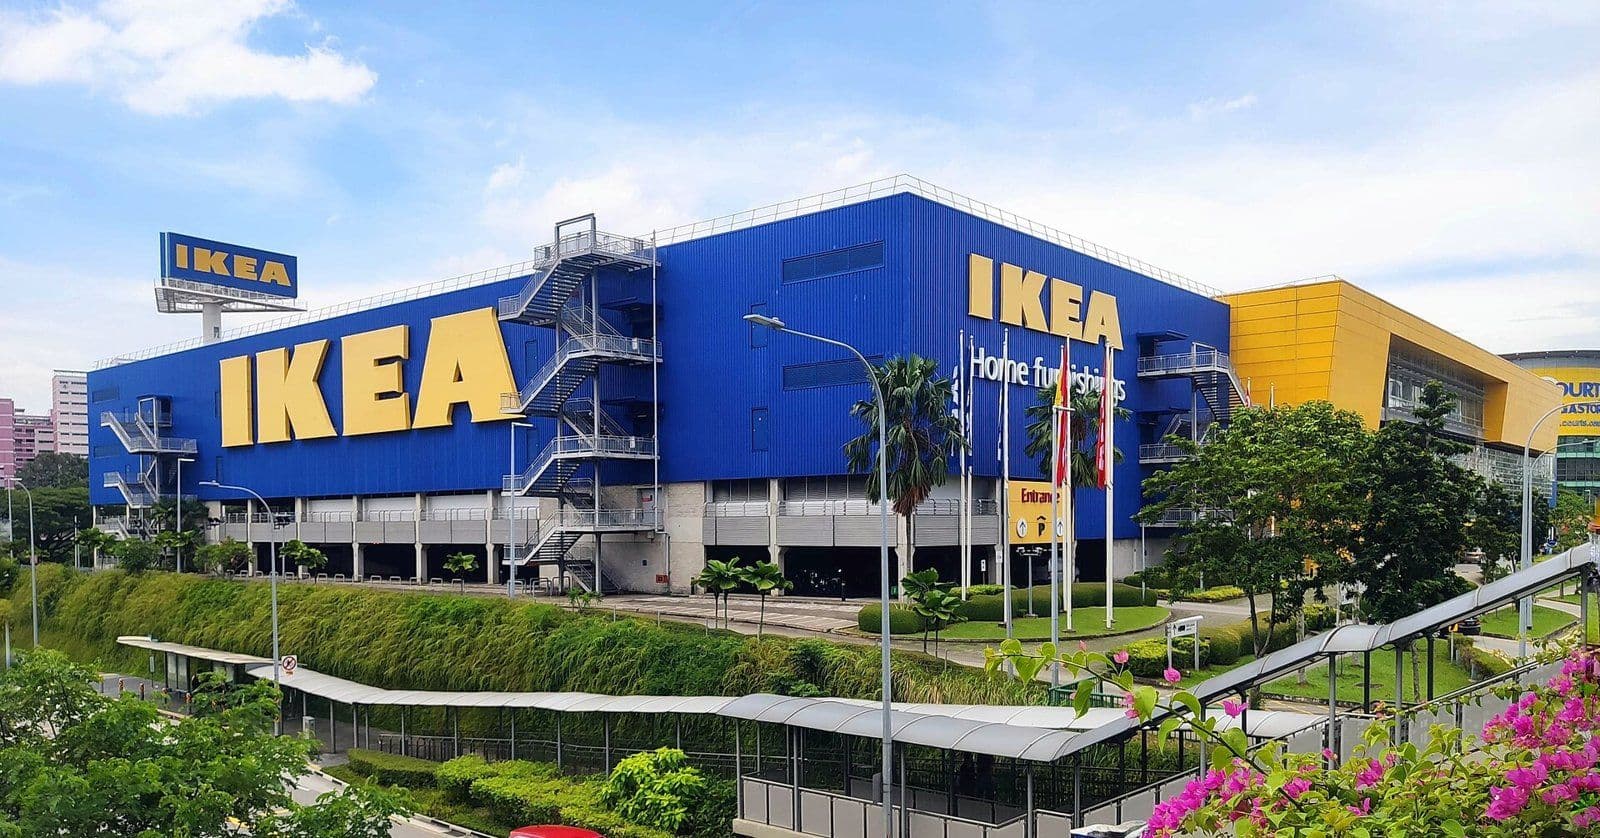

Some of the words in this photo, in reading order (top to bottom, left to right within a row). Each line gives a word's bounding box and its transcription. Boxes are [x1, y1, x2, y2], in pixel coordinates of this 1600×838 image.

[175, 243, 292, 287] IKEA
[968, 253, 1125, 351] IKEA
[219, 307, 527, 447] IKEA
[970, 347, 1029, 386] Home
